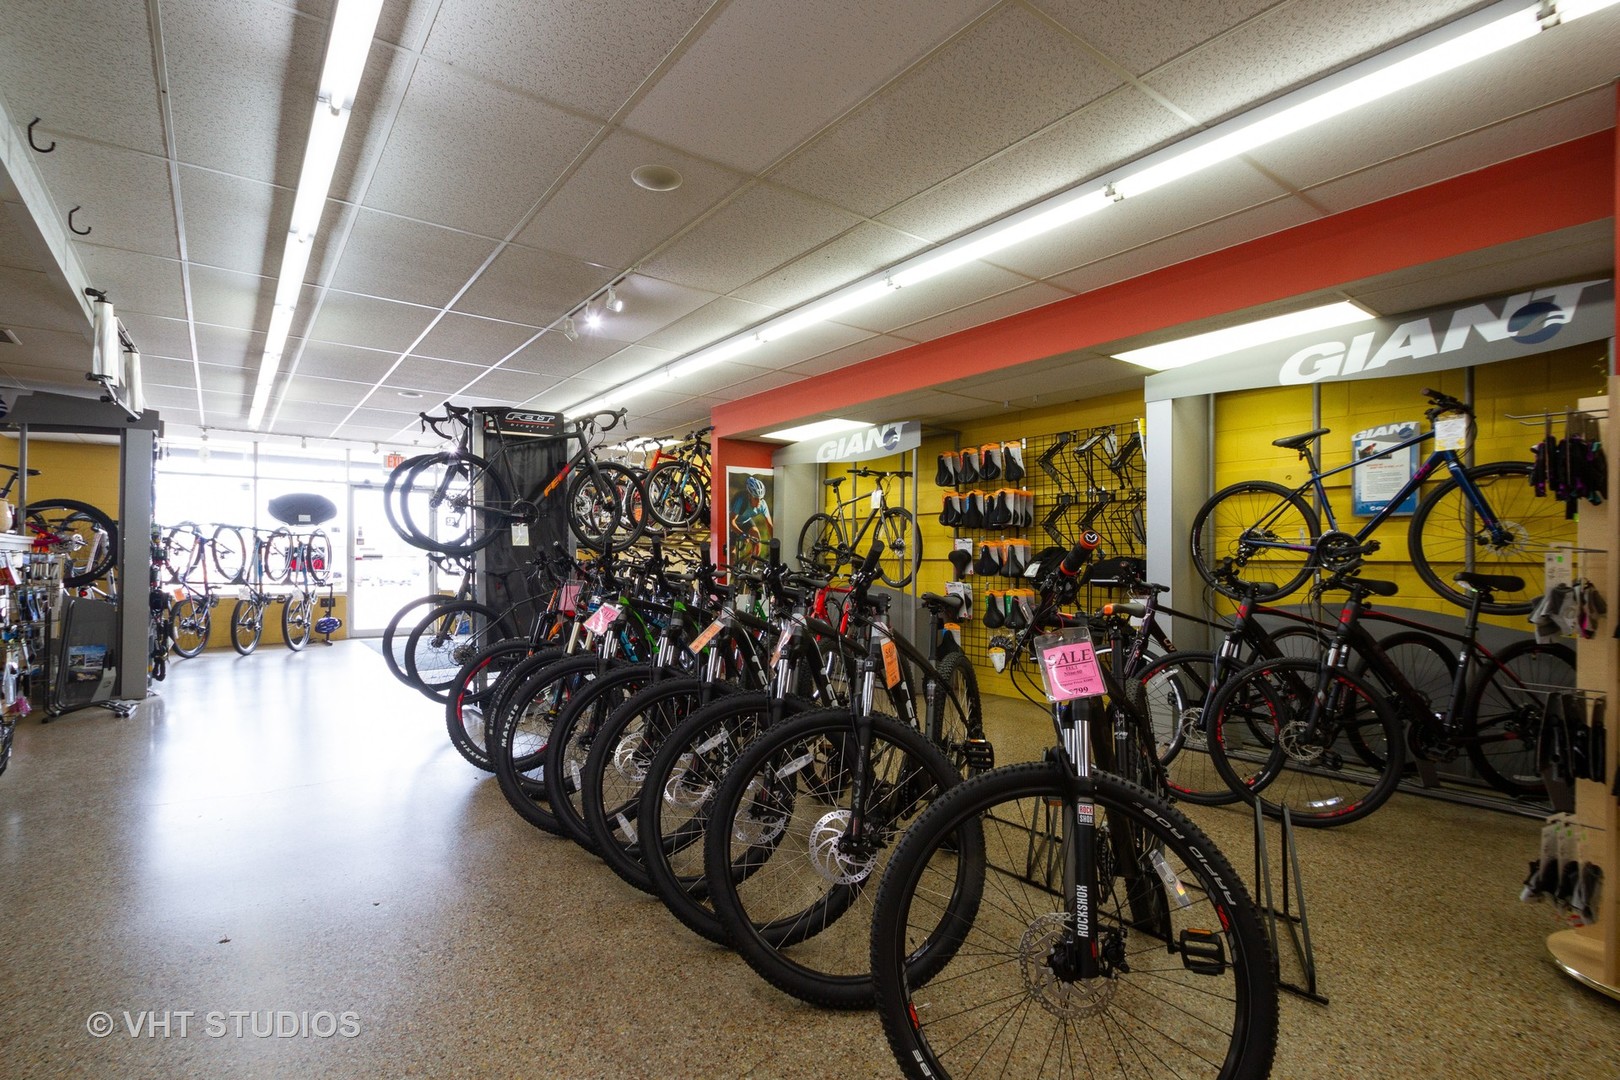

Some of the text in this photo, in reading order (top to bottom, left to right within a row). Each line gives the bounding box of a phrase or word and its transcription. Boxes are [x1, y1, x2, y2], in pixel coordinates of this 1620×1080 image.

[1279, 278, 1612, 386] GIANT
[505, 411, 556, 423] FELT
[1353, 421, 1418, 441] GIANT
[816, 420, 910, 464] GIANT
[1048, 648, 1092, 666] SALE
[501, 703, 519, 748] MAXXIS
[460, 740, 488, 763] MAXXIS
[1143, 808, 1237, 906] RAPID ROB
[1076, 885, 1090, 938] ROCKSHOX
